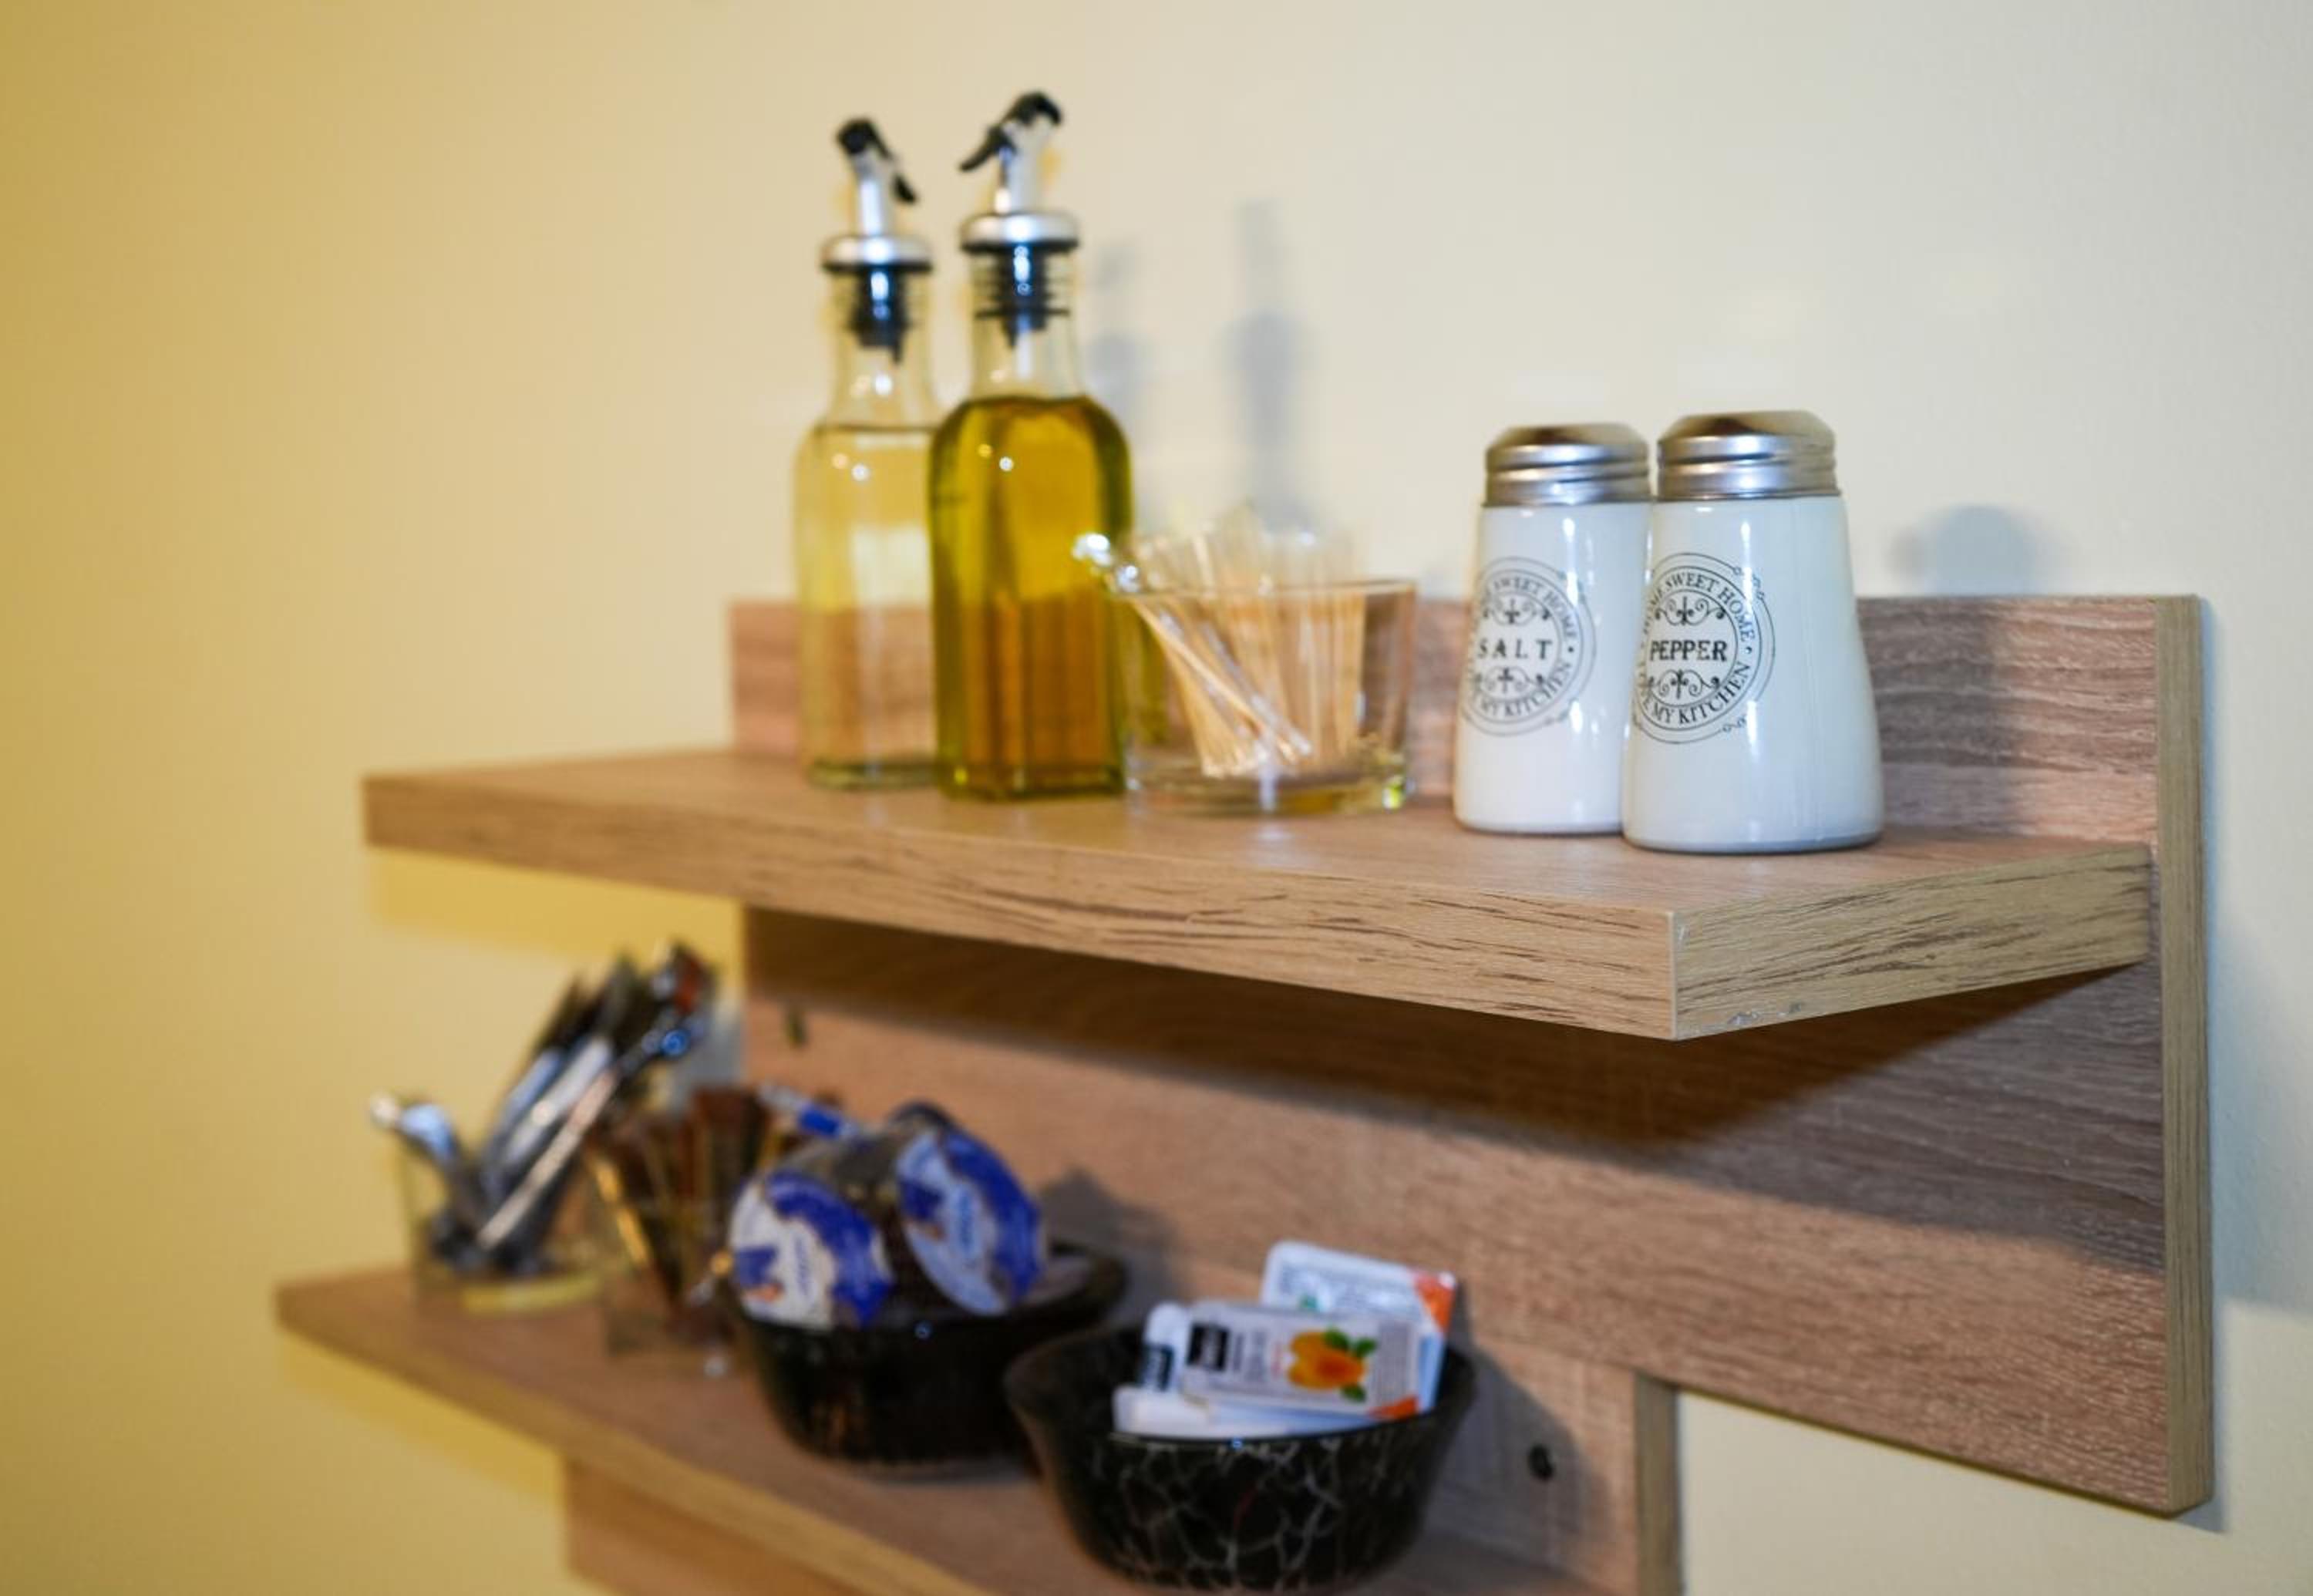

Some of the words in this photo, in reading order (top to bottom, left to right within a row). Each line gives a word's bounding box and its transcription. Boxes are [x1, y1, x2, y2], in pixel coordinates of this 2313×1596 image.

[1542, 589, 1578, 639] HOME
[1665, 571, 1721, 594] SWEET
[1718, 587, 1756, 642] HOME
[1476, 638, 1553, 661] SALT
[1648, 638, 1729, 663] PEPPER
[1503, 661, 1572, 718] KITCHEN
[1651, 704, 1677, 724] MY
[1678, 661, 1750, 726] KITCHEN
